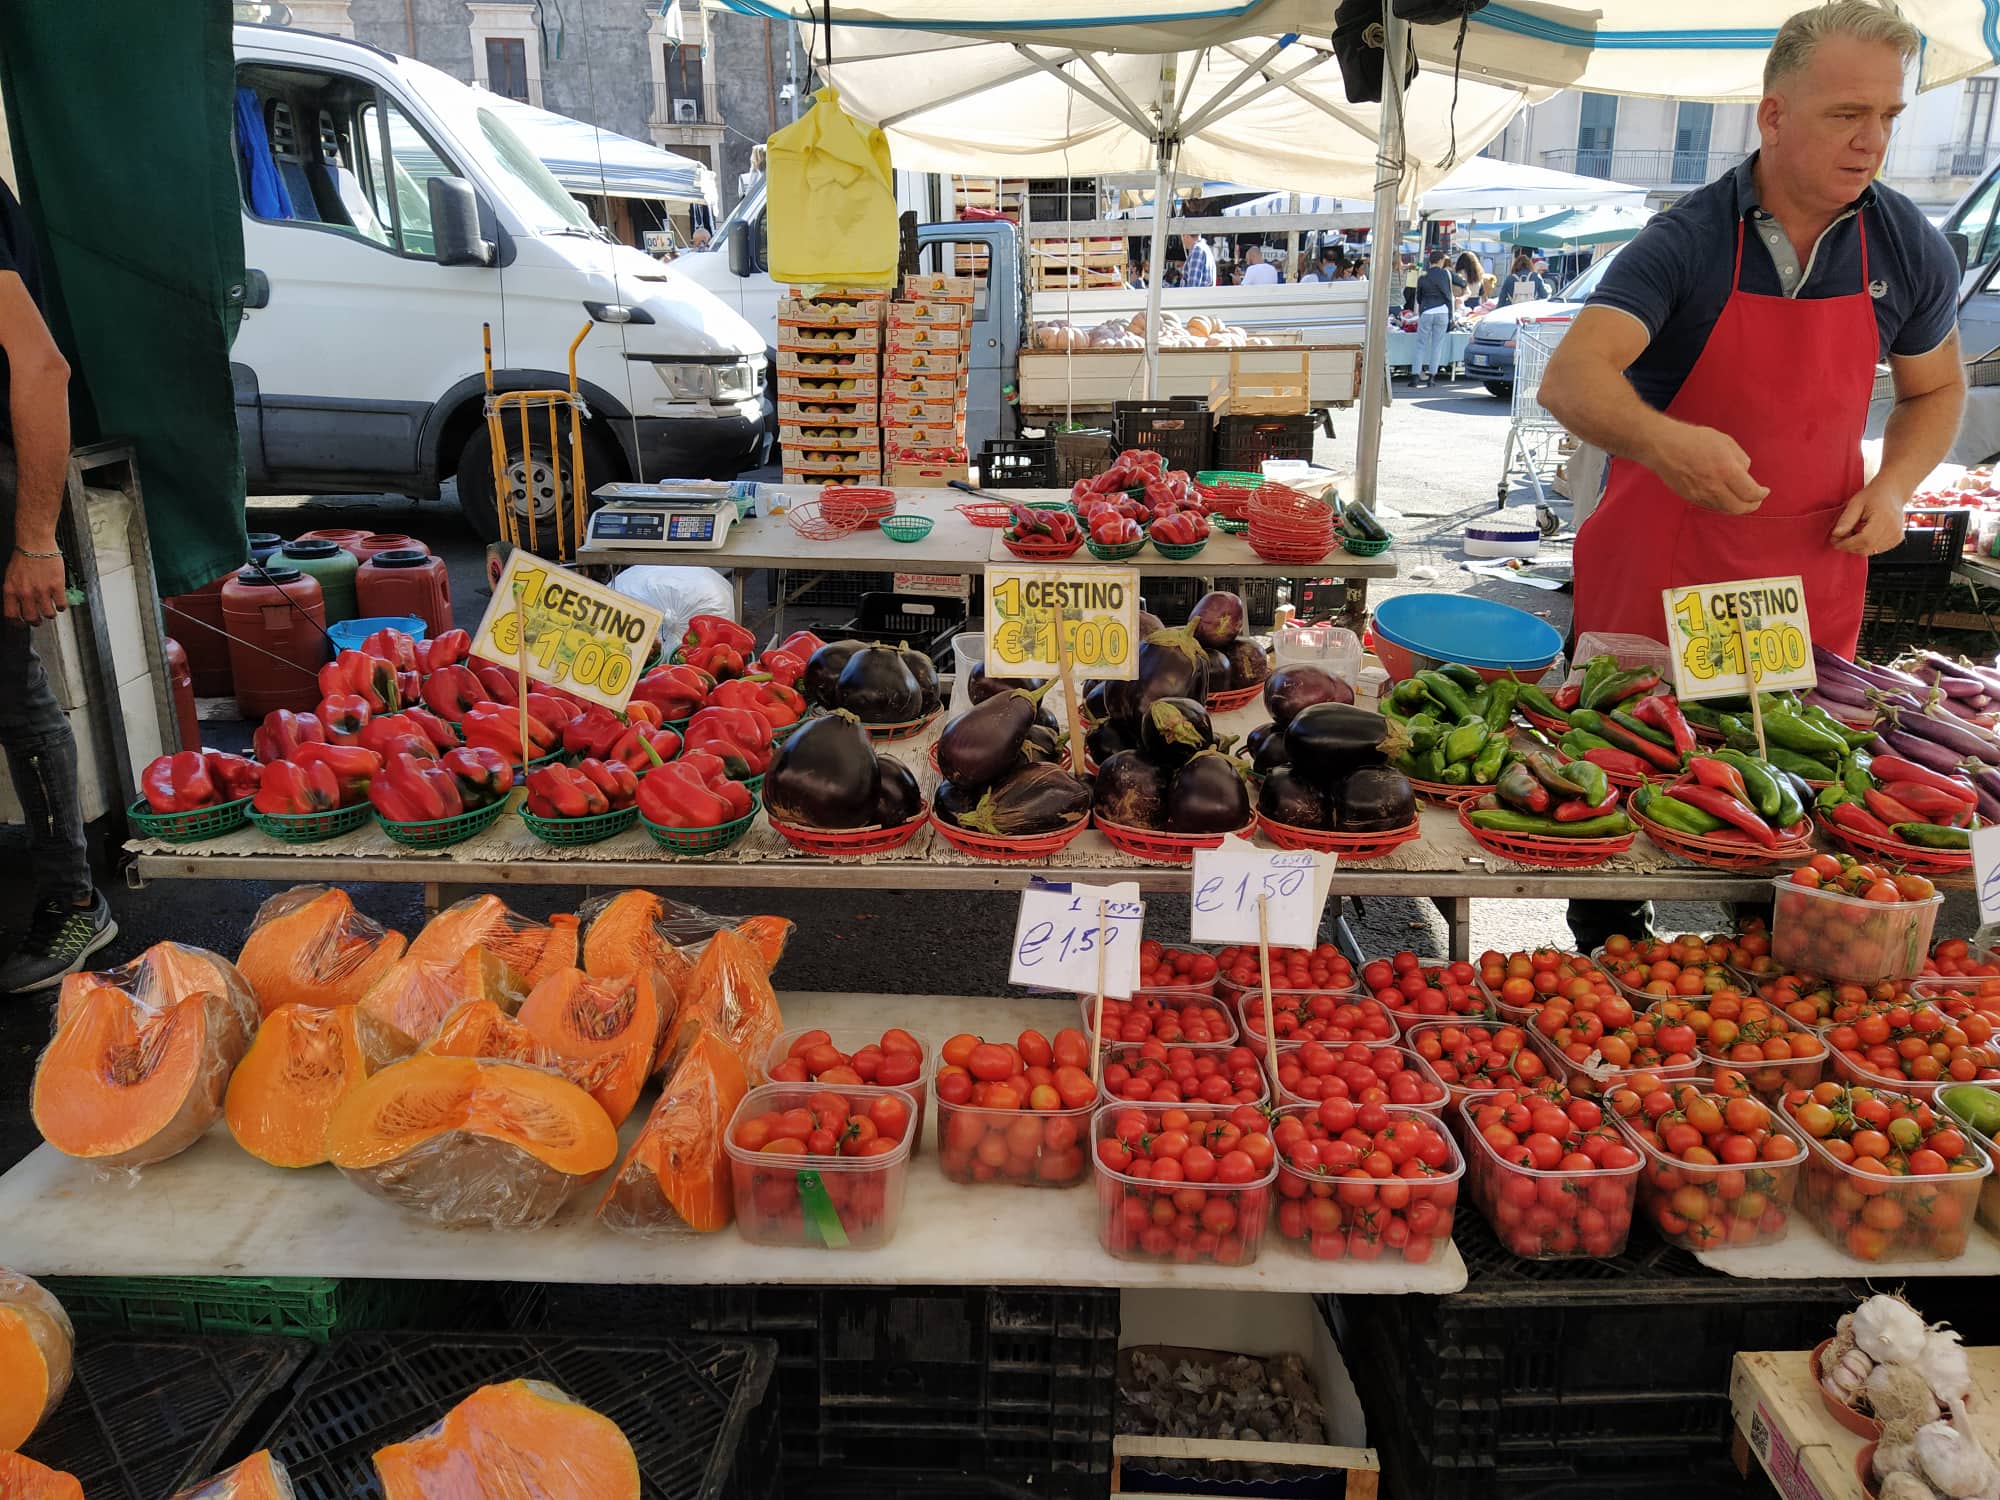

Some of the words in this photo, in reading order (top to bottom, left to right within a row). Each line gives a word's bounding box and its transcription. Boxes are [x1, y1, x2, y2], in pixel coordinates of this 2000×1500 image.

[513, 568, 548, 608] 1
[543, 583, 646, 644] CESTINO
[992, 578, 1020, 616] 1
[1025, 581, 1124, 610] CESTINO
[1675, 592, 1705, 631] 1
[1711, 587, 1798, 621] CESTINO
[1068, 896, 1082, 910] 1
